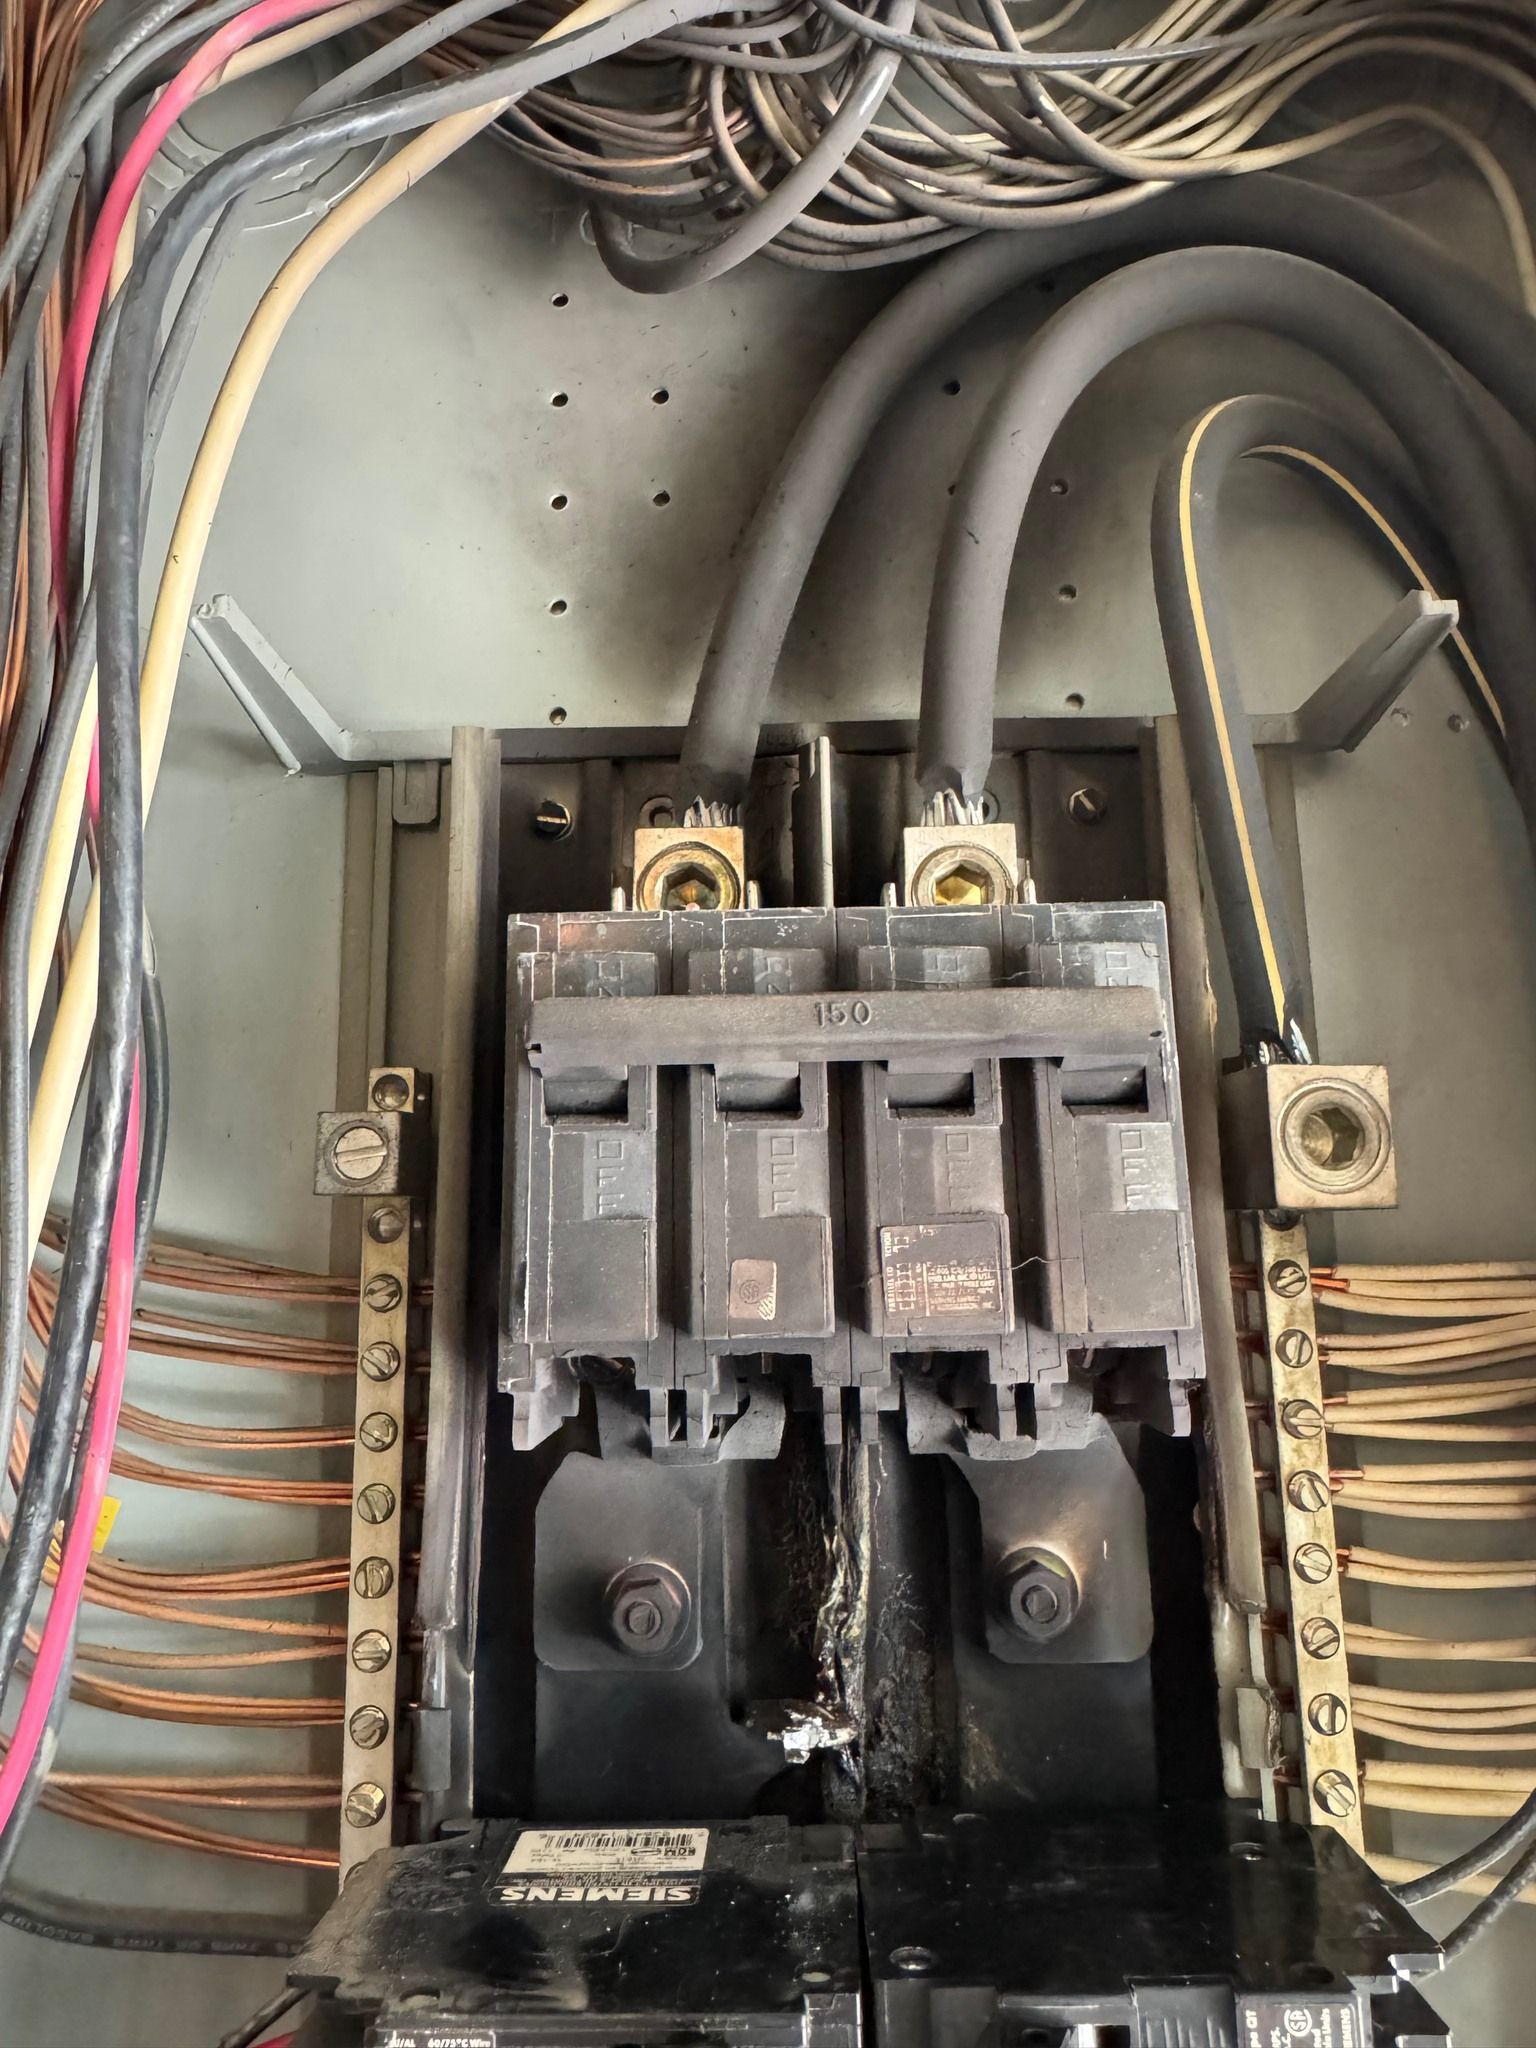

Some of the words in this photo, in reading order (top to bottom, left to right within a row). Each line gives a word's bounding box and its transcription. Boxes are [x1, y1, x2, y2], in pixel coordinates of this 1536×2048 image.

[814, 1000, 872, 1027] 150
[597, 1139, 625, 1215] OFF
[769, 1136, 798, 1212] OFF
[500, 1886, 692, 1902] SIEMENS
